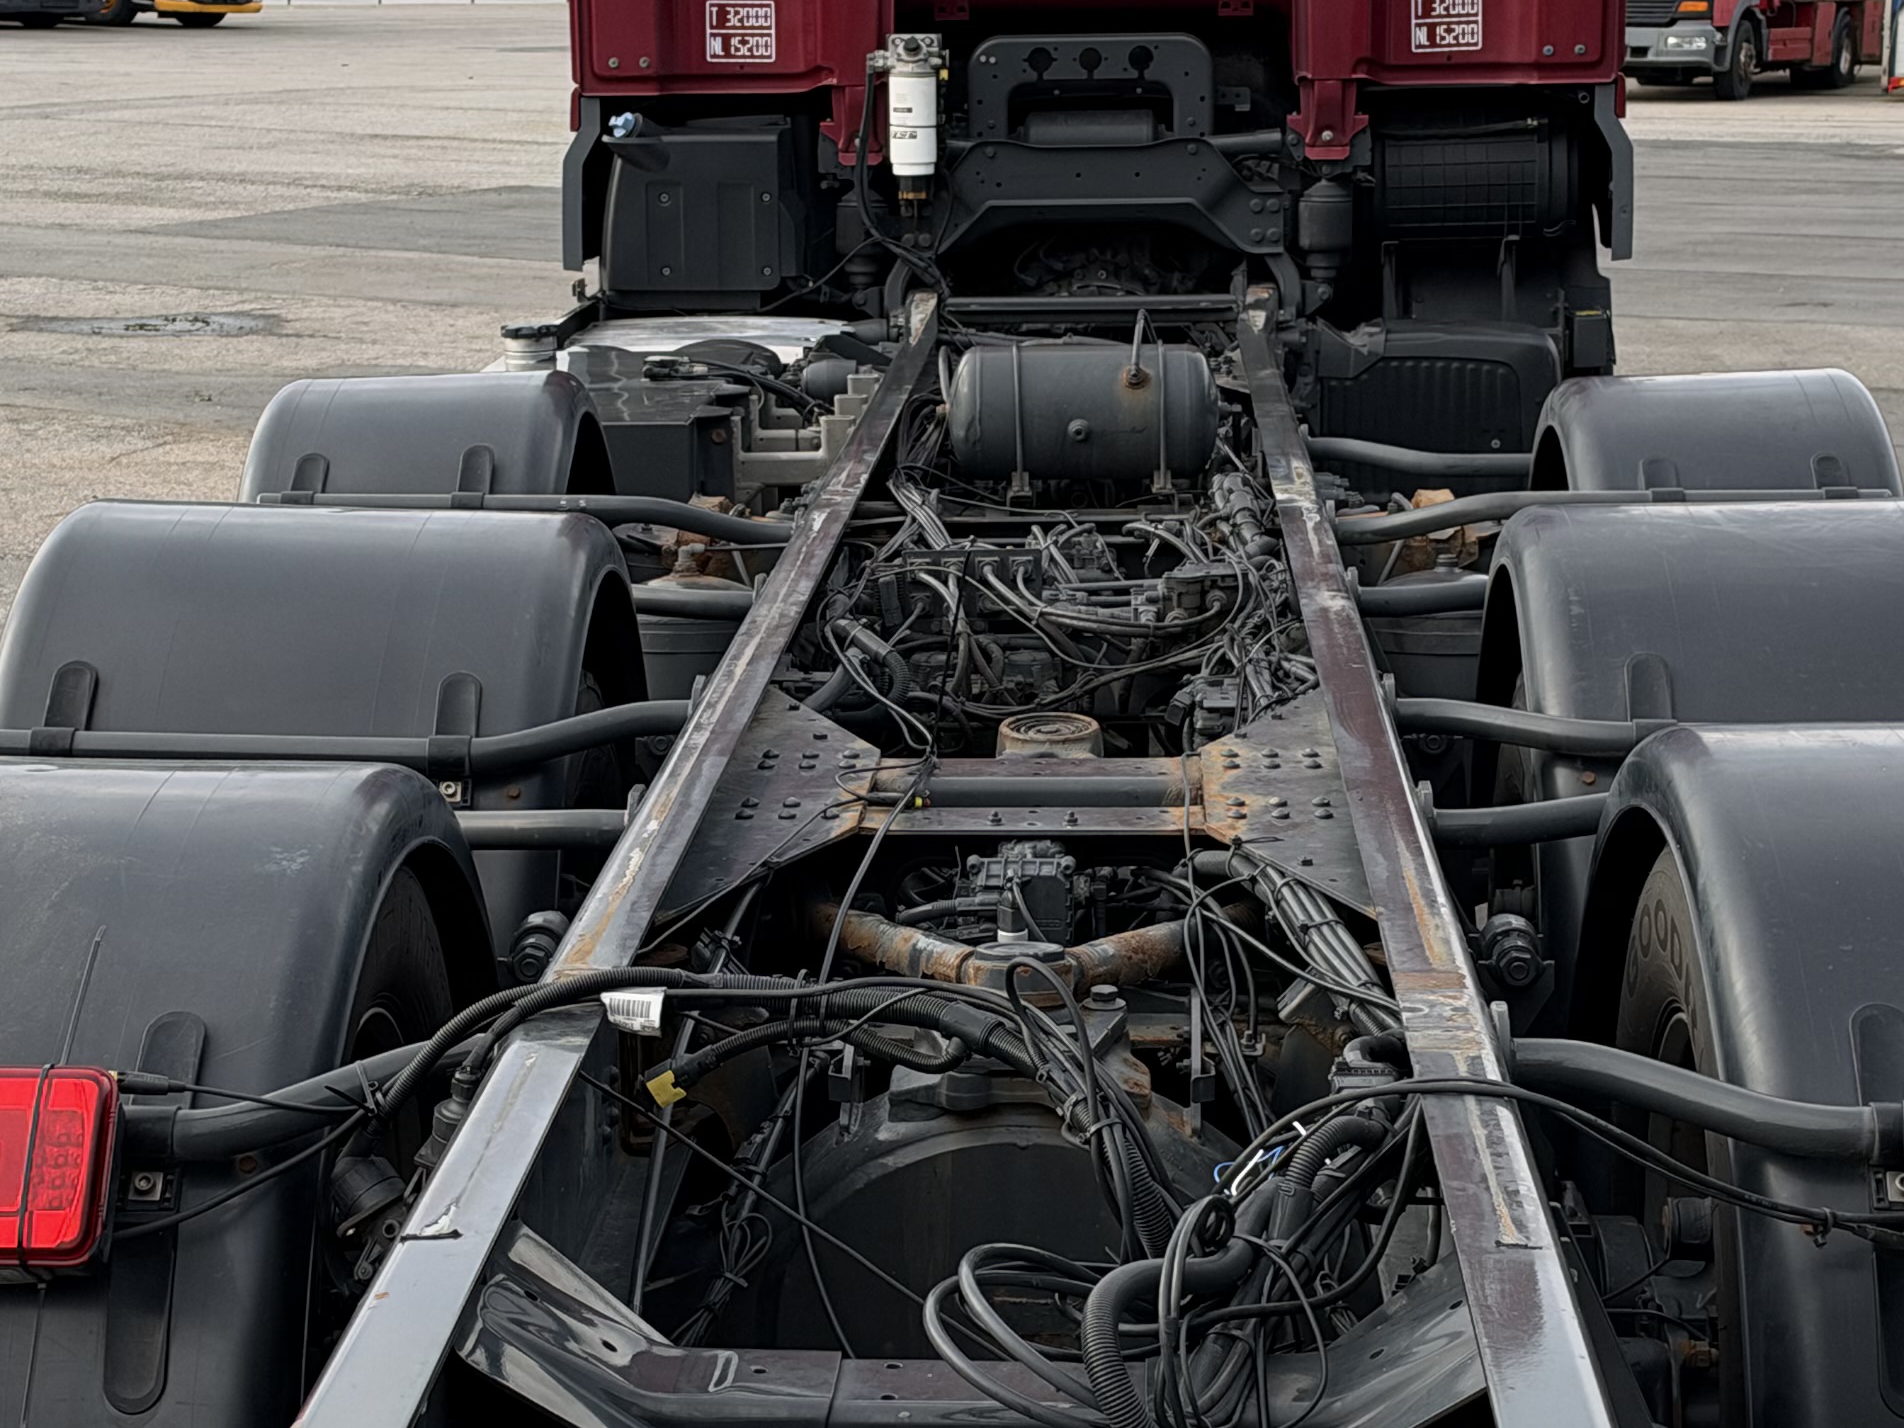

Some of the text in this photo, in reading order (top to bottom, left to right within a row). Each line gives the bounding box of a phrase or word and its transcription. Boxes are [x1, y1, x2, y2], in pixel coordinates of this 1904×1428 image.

[710, 6, 771, 26] T 32000
[1416, 23, 1477, 45] NL 15200
[710, 36, 771, 55] NL 15200
